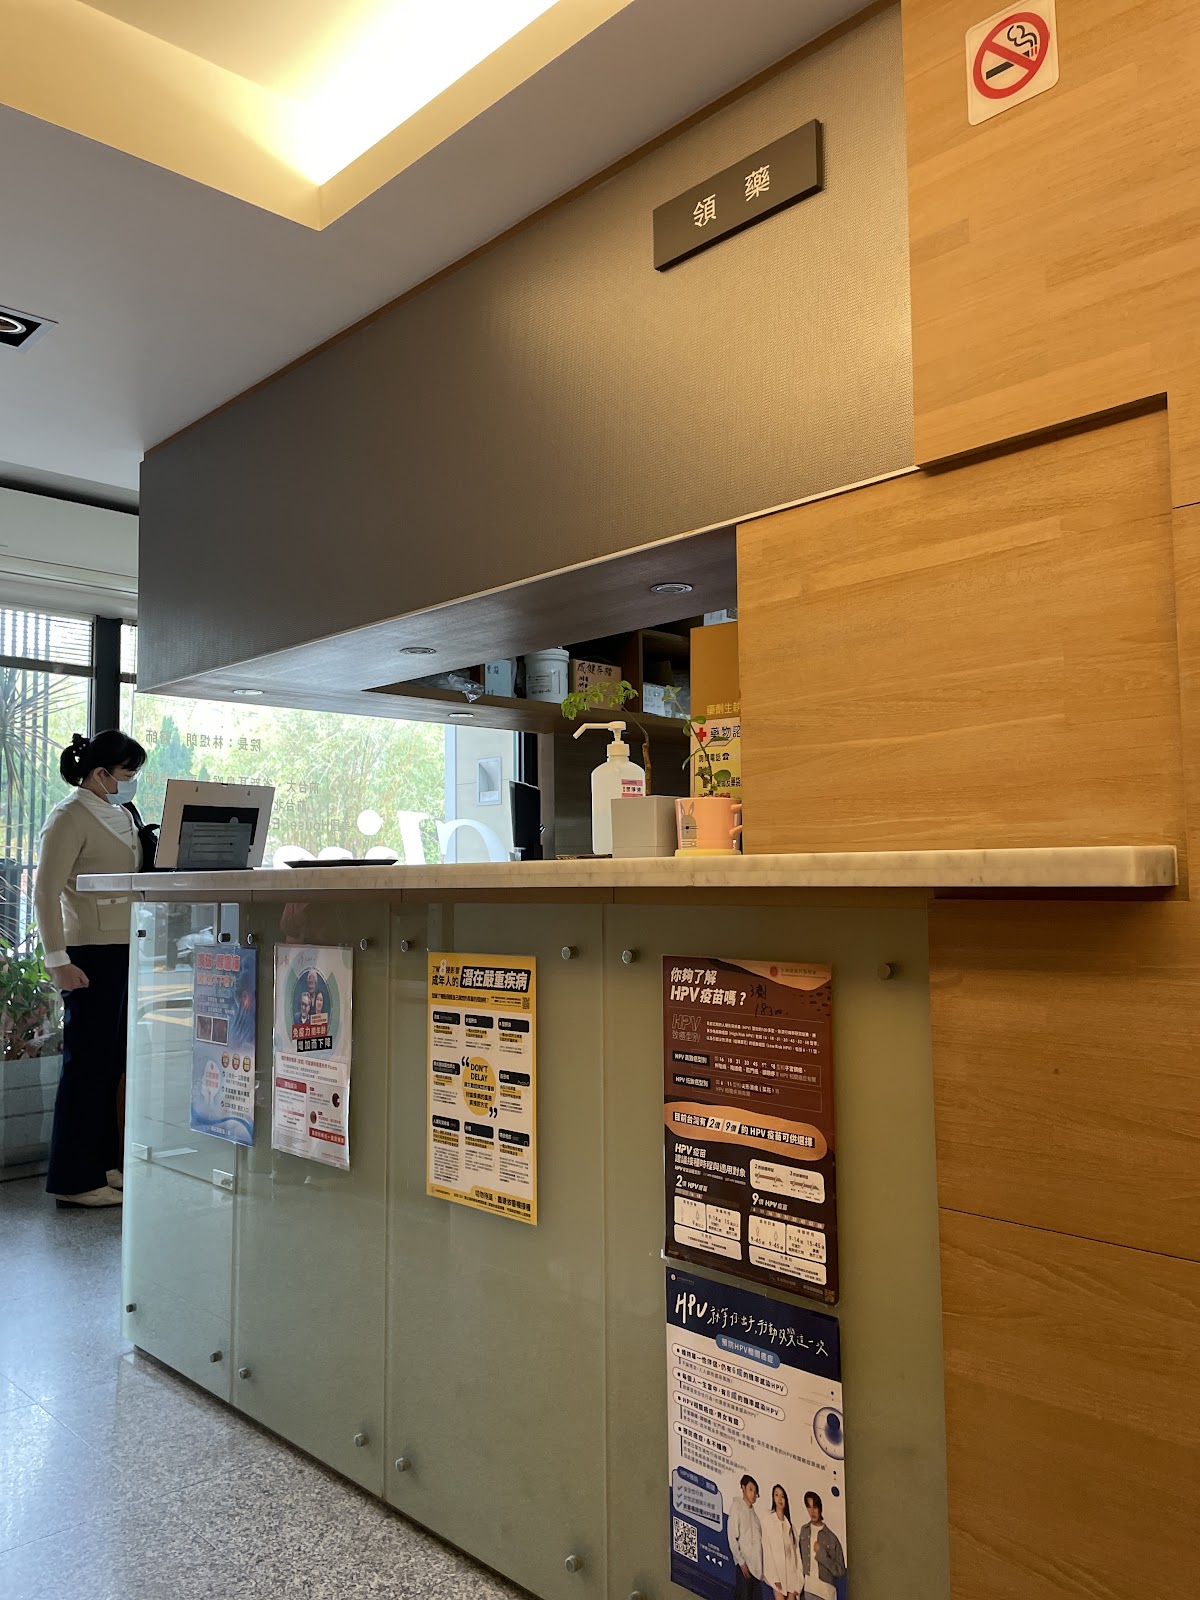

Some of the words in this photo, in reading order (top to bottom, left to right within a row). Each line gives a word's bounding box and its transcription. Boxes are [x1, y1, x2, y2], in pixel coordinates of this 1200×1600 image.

[462, 968, 528, 991] 潛在嚴重疾病
[670, 967, 717, 986] 你夠了解
[670, 985, 700, 1003] HPV
[700, 988, 748, 1007] 疫苗嗎？
[671, 1013, 702, 1031] HPV
[470, 1063, 488, 1073] DON'T
[470, 1073, 488, 1082] DELAY
[750, 1127, 766, 1138] HPV
[674, 1143, 692, 1155] HPV
[675, 1292, 708, 1324] HPV
